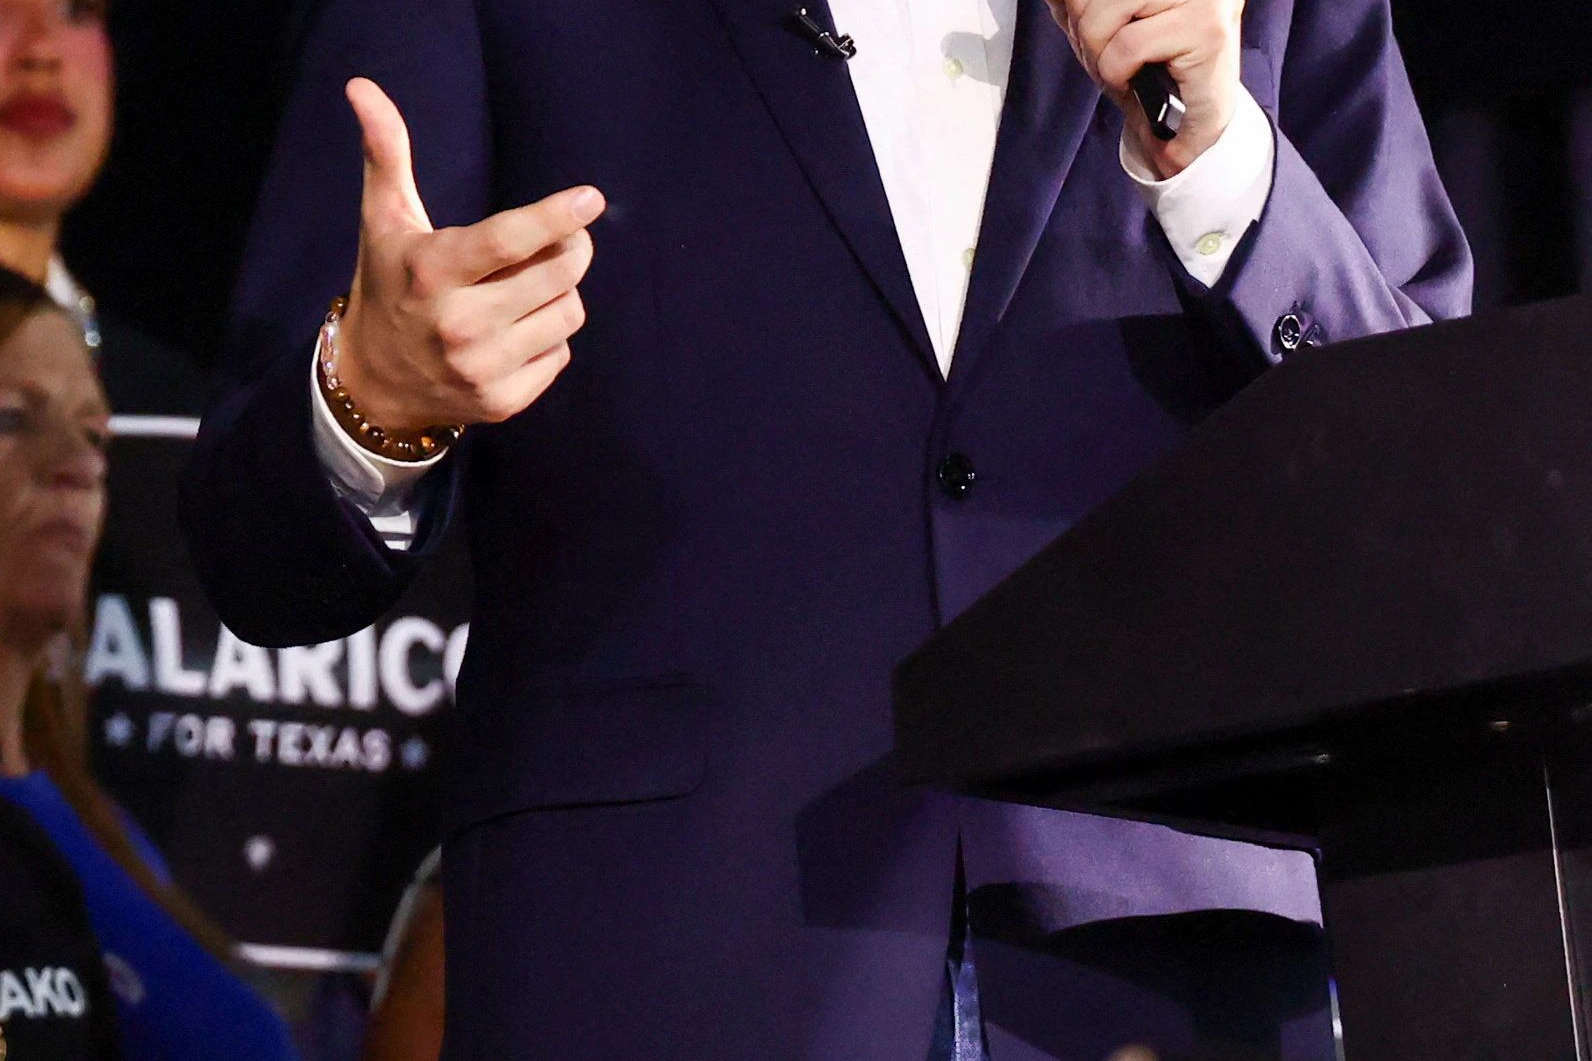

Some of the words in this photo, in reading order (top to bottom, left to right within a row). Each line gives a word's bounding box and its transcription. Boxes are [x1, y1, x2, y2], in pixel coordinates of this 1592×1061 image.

[84, 593, 470, 716] ALARIC
[148, 713, 235, 761] FOR
[249, 718, 390, 772] TEXAS
